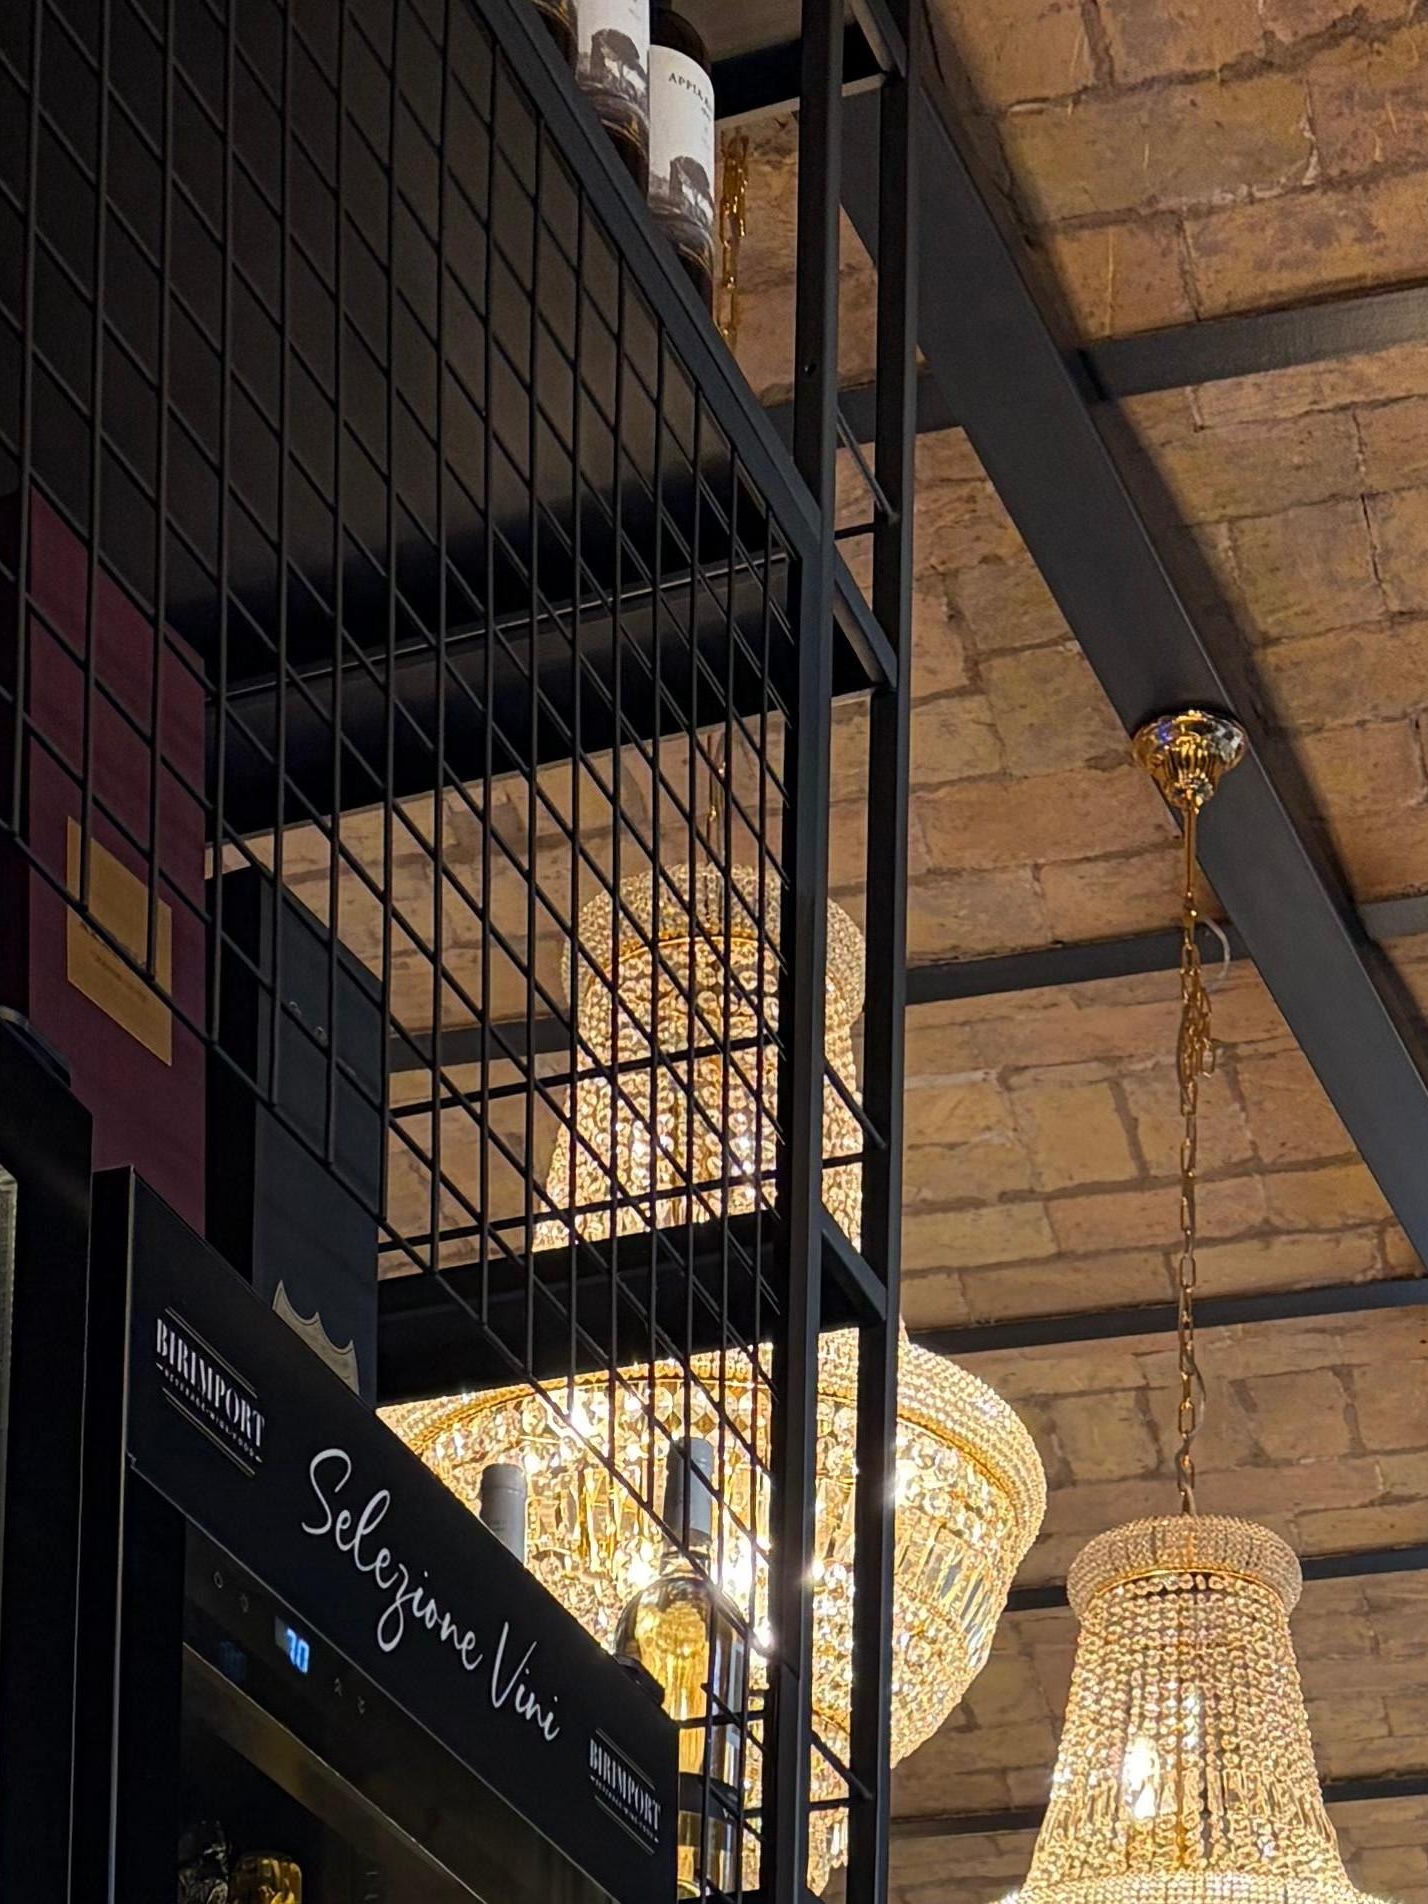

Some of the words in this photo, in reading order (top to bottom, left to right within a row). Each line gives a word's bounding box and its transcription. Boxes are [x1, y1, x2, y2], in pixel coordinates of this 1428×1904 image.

[155, 1318, 266, 1447] BIRIMPORT
[301, 1448, 484, 1671] Selezione
[491, 1621, 561, 1742] Vini
[589, 1738, 662, 1831] BIRIMPORT
